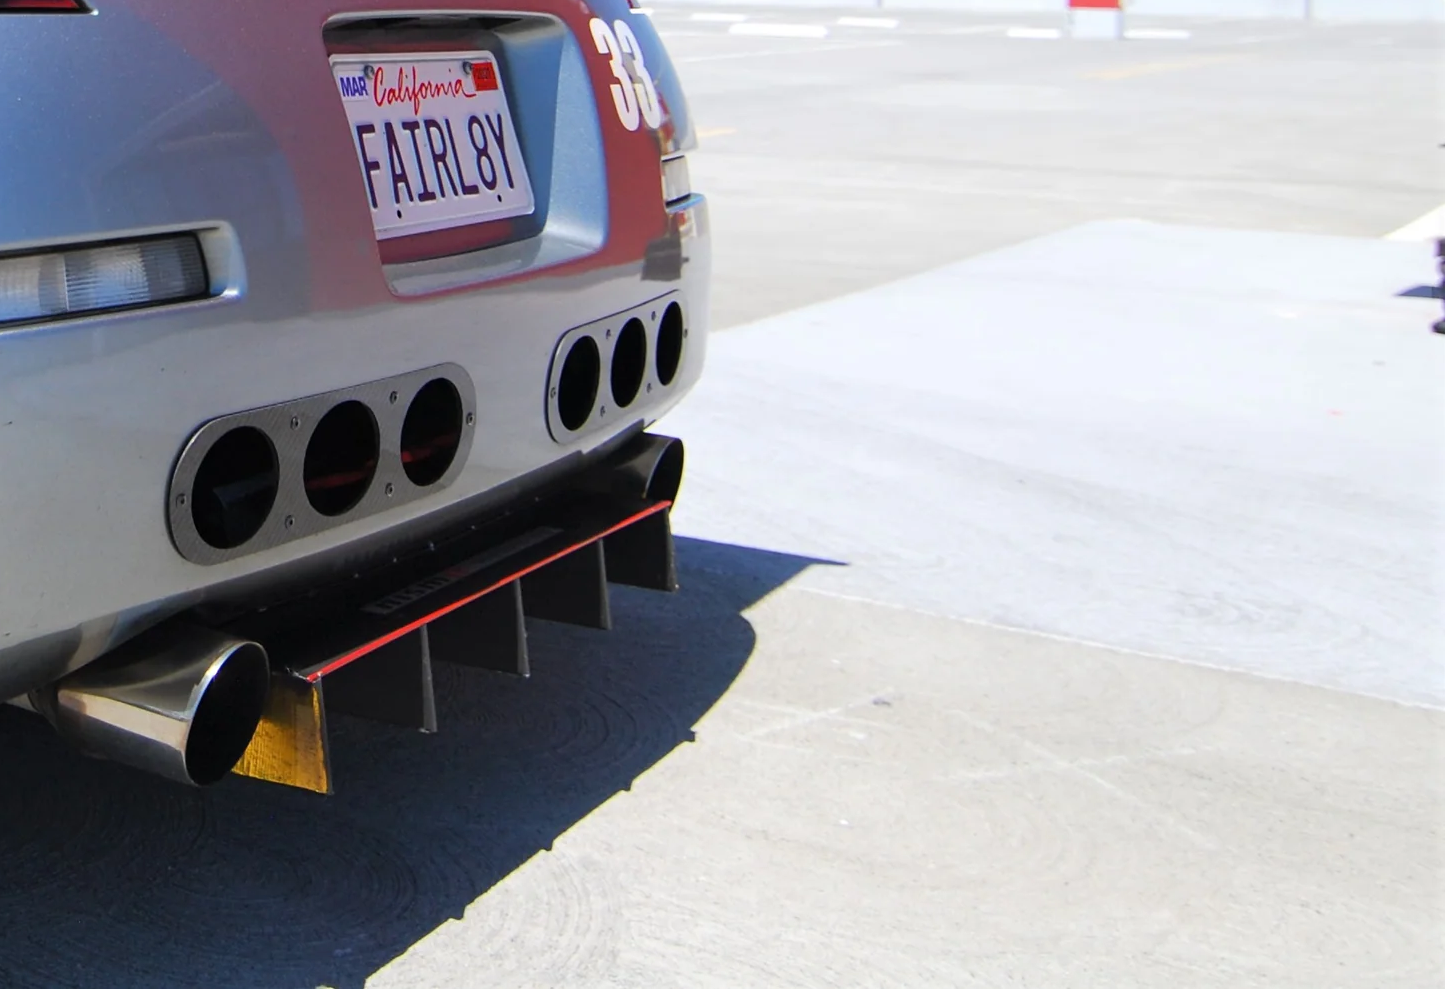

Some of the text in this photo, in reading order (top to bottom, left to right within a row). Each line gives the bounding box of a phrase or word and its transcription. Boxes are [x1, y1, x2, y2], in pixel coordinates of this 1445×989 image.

[340, 75, 369, 98] MAR
[373, 66, 477, 116] California
[589, 17, 662, 132] 33
[355, 112, 515, 210] FAIRL8Y
